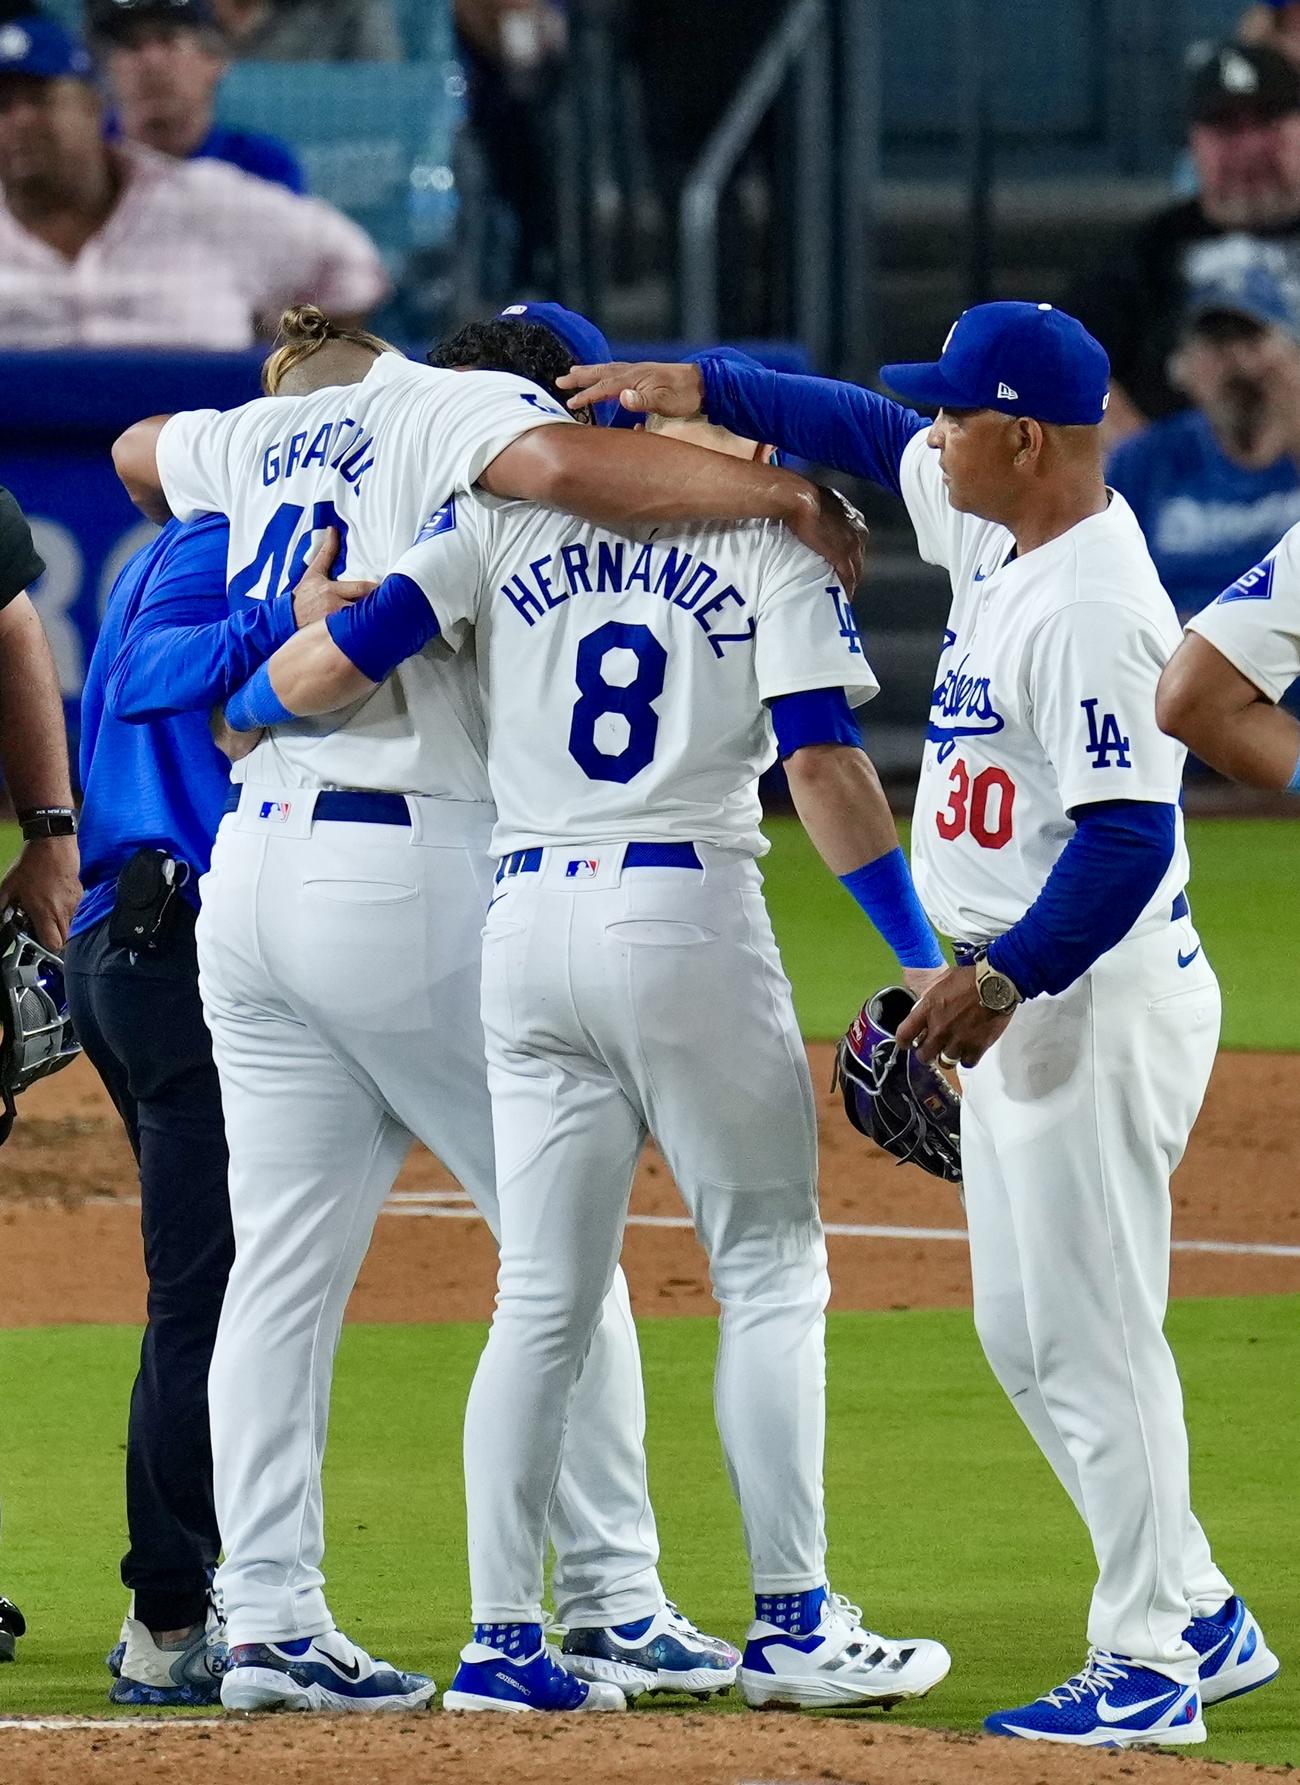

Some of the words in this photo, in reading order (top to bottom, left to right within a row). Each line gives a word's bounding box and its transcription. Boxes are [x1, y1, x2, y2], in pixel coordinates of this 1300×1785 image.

[568, 620, 668, 785] 8
[1080, 698, 1132, 769] LA
[936, 757, 1016, 850] 30
